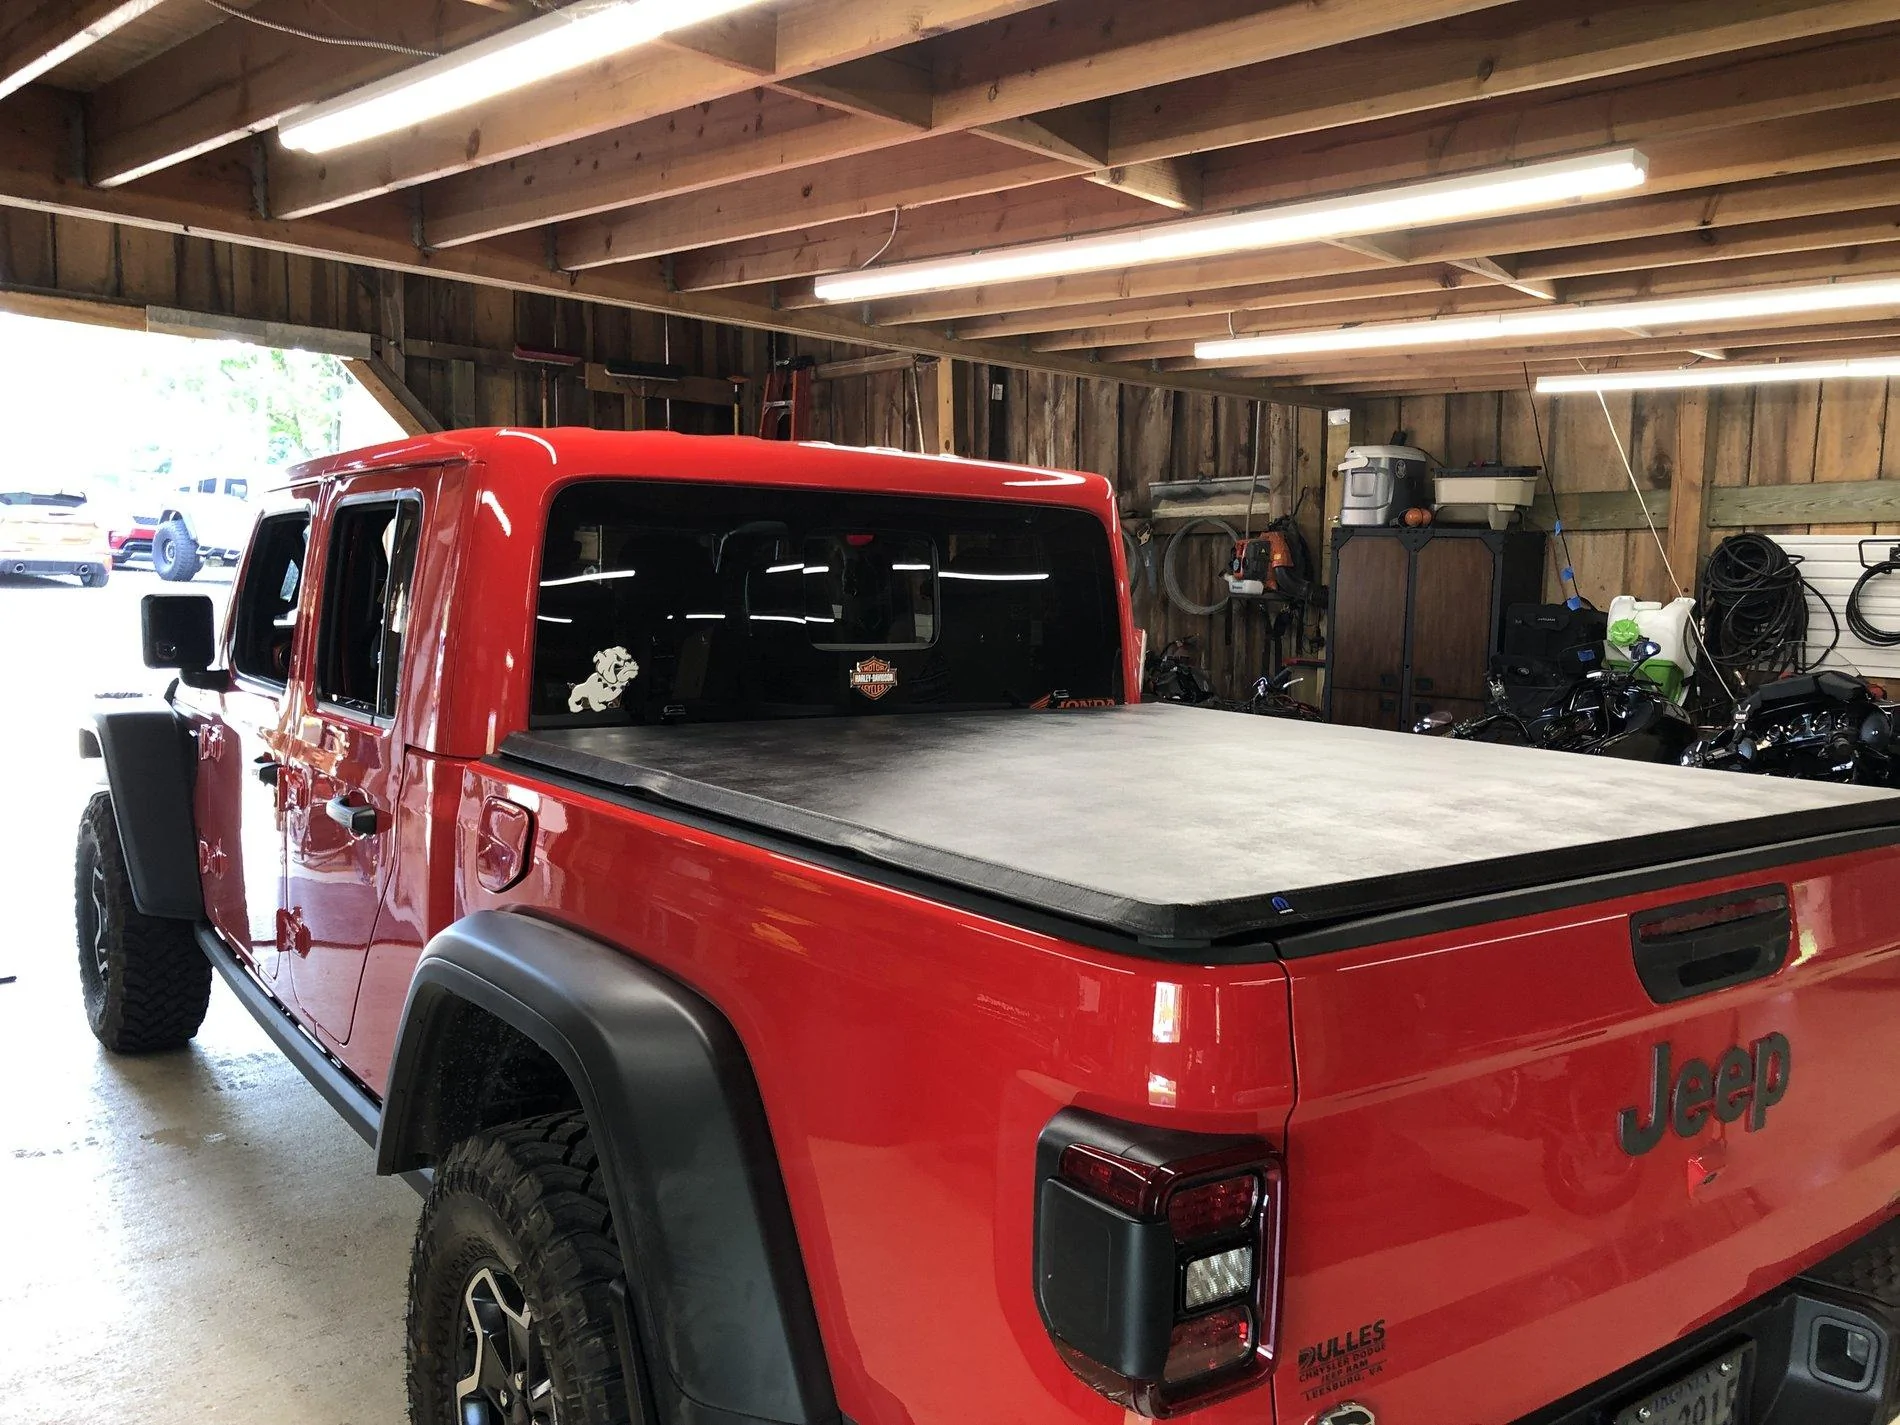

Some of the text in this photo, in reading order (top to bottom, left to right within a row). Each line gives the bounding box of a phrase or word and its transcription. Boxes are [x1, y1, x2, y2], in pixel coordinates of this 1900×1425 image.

[854, 673, 894, 683] HARLEY-DAVIDSON
[862, 662, 886, 671] MOTOR
[1617, 1032, 1791, 1156] Jeep
[1298, 1319, 1386, 1370] DULLES
[1299, 1341, 1386, 1383] CHRYSLER DODGE
[1321, 1359, 1369, 1384] JEEP RAM
[1369, 1365, 1384, 1376] VA
